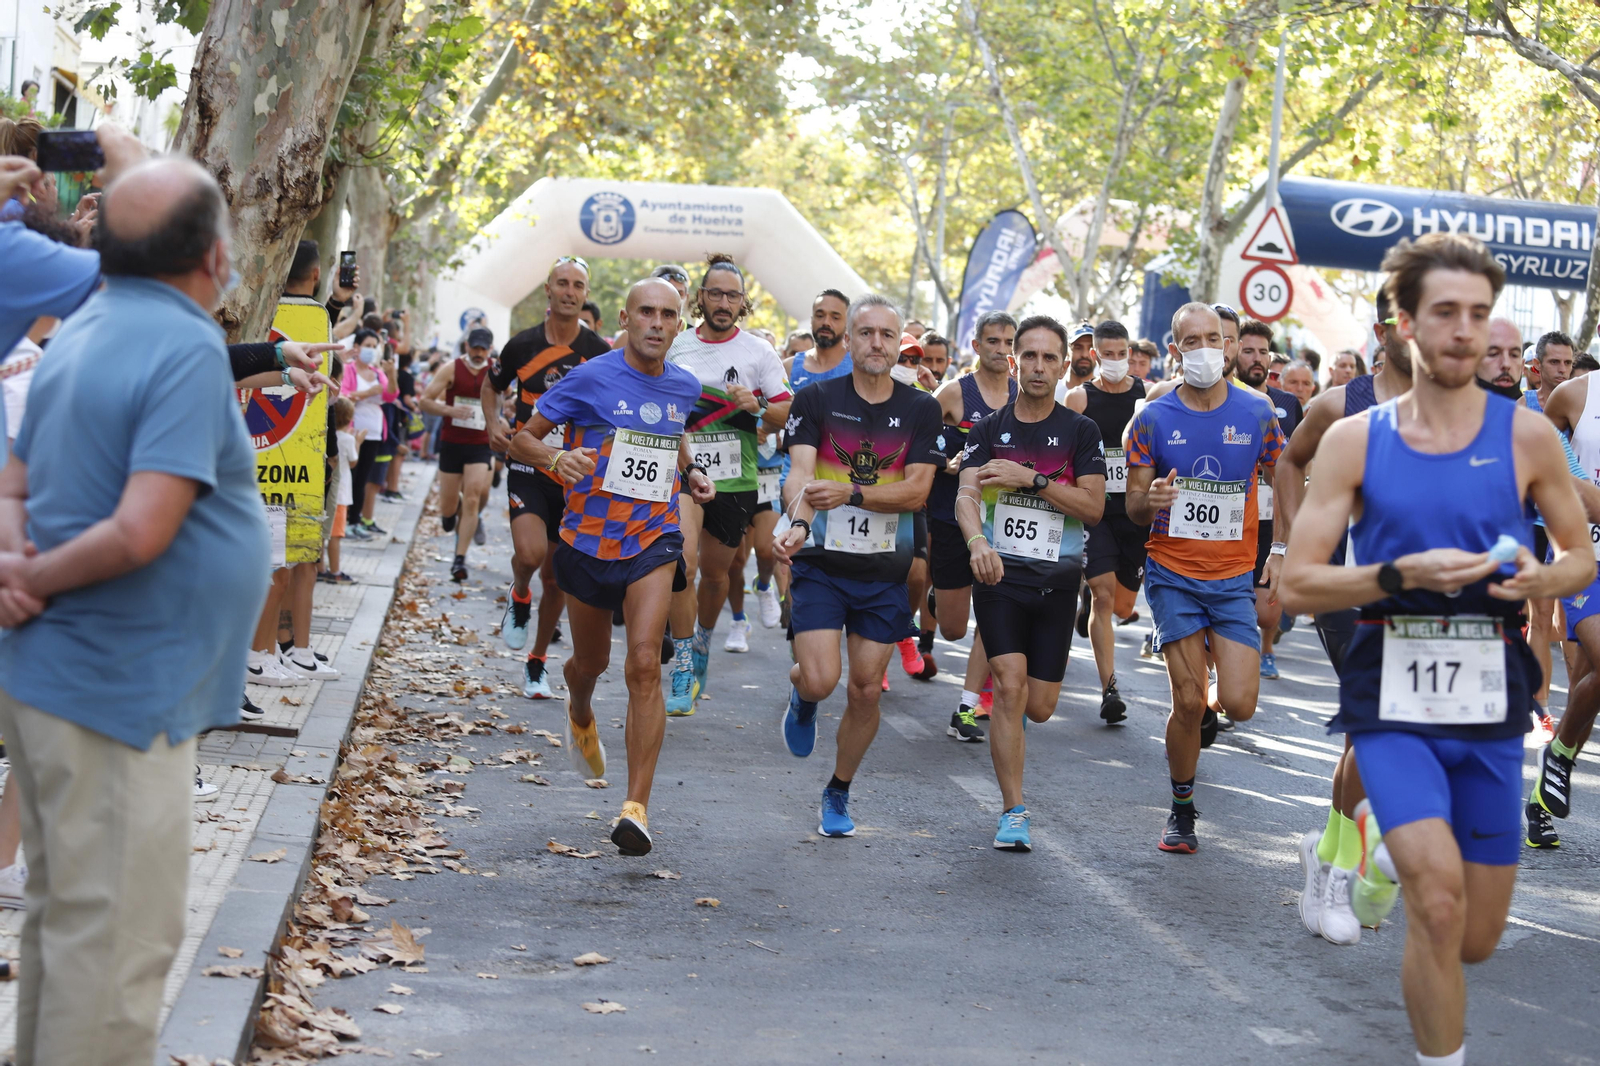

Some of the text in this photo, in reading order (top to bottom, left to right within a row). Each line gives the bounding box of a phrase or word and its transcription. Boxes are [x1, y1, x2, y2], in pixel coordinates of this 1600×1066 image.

[640, 199, 744, 213] Ayuntamiento
[669, 214, 743, 226] de Huelva
[1412, 207, 1591, 251] HYUNDAI
[1494, 253, 1588, 280] SYRLUZ
[1253, 283, 1282, 302] 30
[621, 433, 629, 442] 34
[631, 433, 654, 447] VUELTA
[654, 438, 660, 447] A
[695, 434, 712, 442] VUELTA
[717, 432, 736, 441] HUELVA
[694, 451, 721, 469] 634
[257, 465, 309, 483] ZONA
[621, 457, 658, 482] 356
[1188, 481, 1211, 492] VUELTA
[1212, 482, 1218, 492] A
[1219, 484, 1241, 493] HUELVA
[1001, 494, 1008, 503] 34
[1009, 495, 1031, 507] VUELTA
[1032, 499, 1037, 508] A
[1184, 502, 1220, 524] 360
[847, 515, 870, 537] 14
[1004, 517, 1038, 541] 655
[1447, 623, 1456, 637] A
[1458, 622, 1495, 638] HUELVA
[1407, 660, 1461, 693] 117
